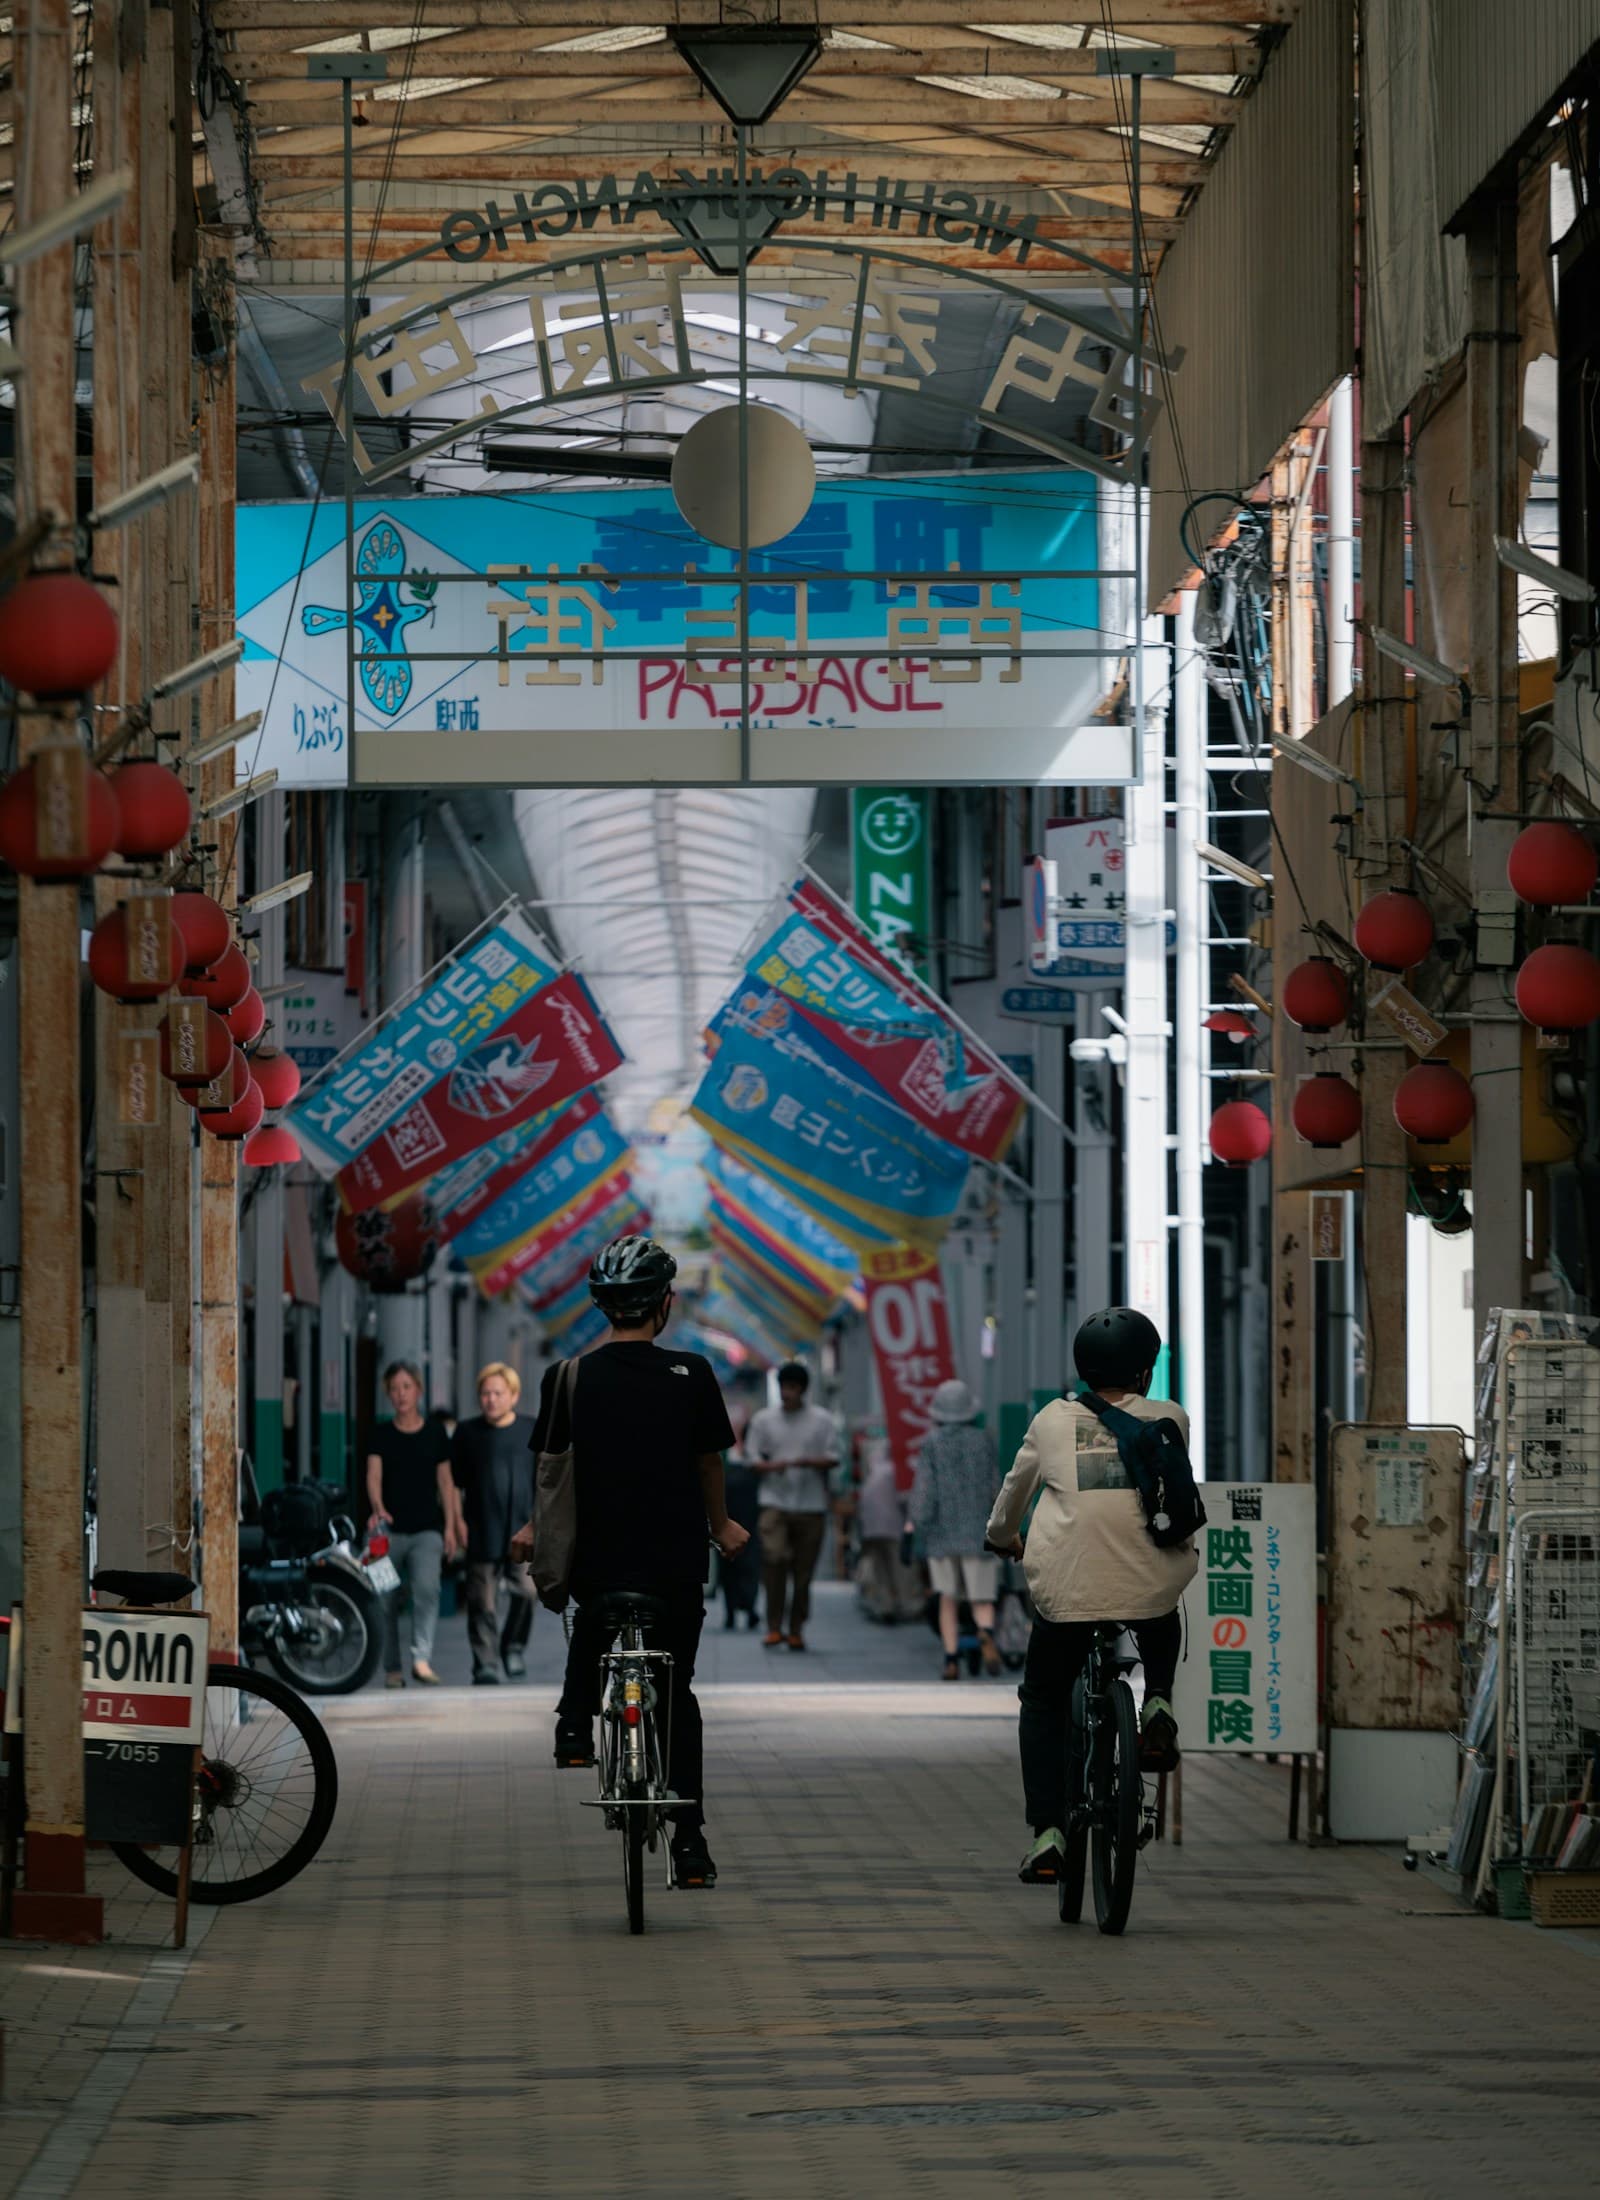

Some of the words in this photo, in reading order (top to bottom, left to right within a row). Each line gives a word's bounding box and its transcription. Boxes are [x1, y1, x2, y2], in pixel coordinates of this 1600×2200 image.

[306, 938, 518, 1134] 岡山シーガルズ
[1207, 1525, 1254, 1745] 映画の冒険
